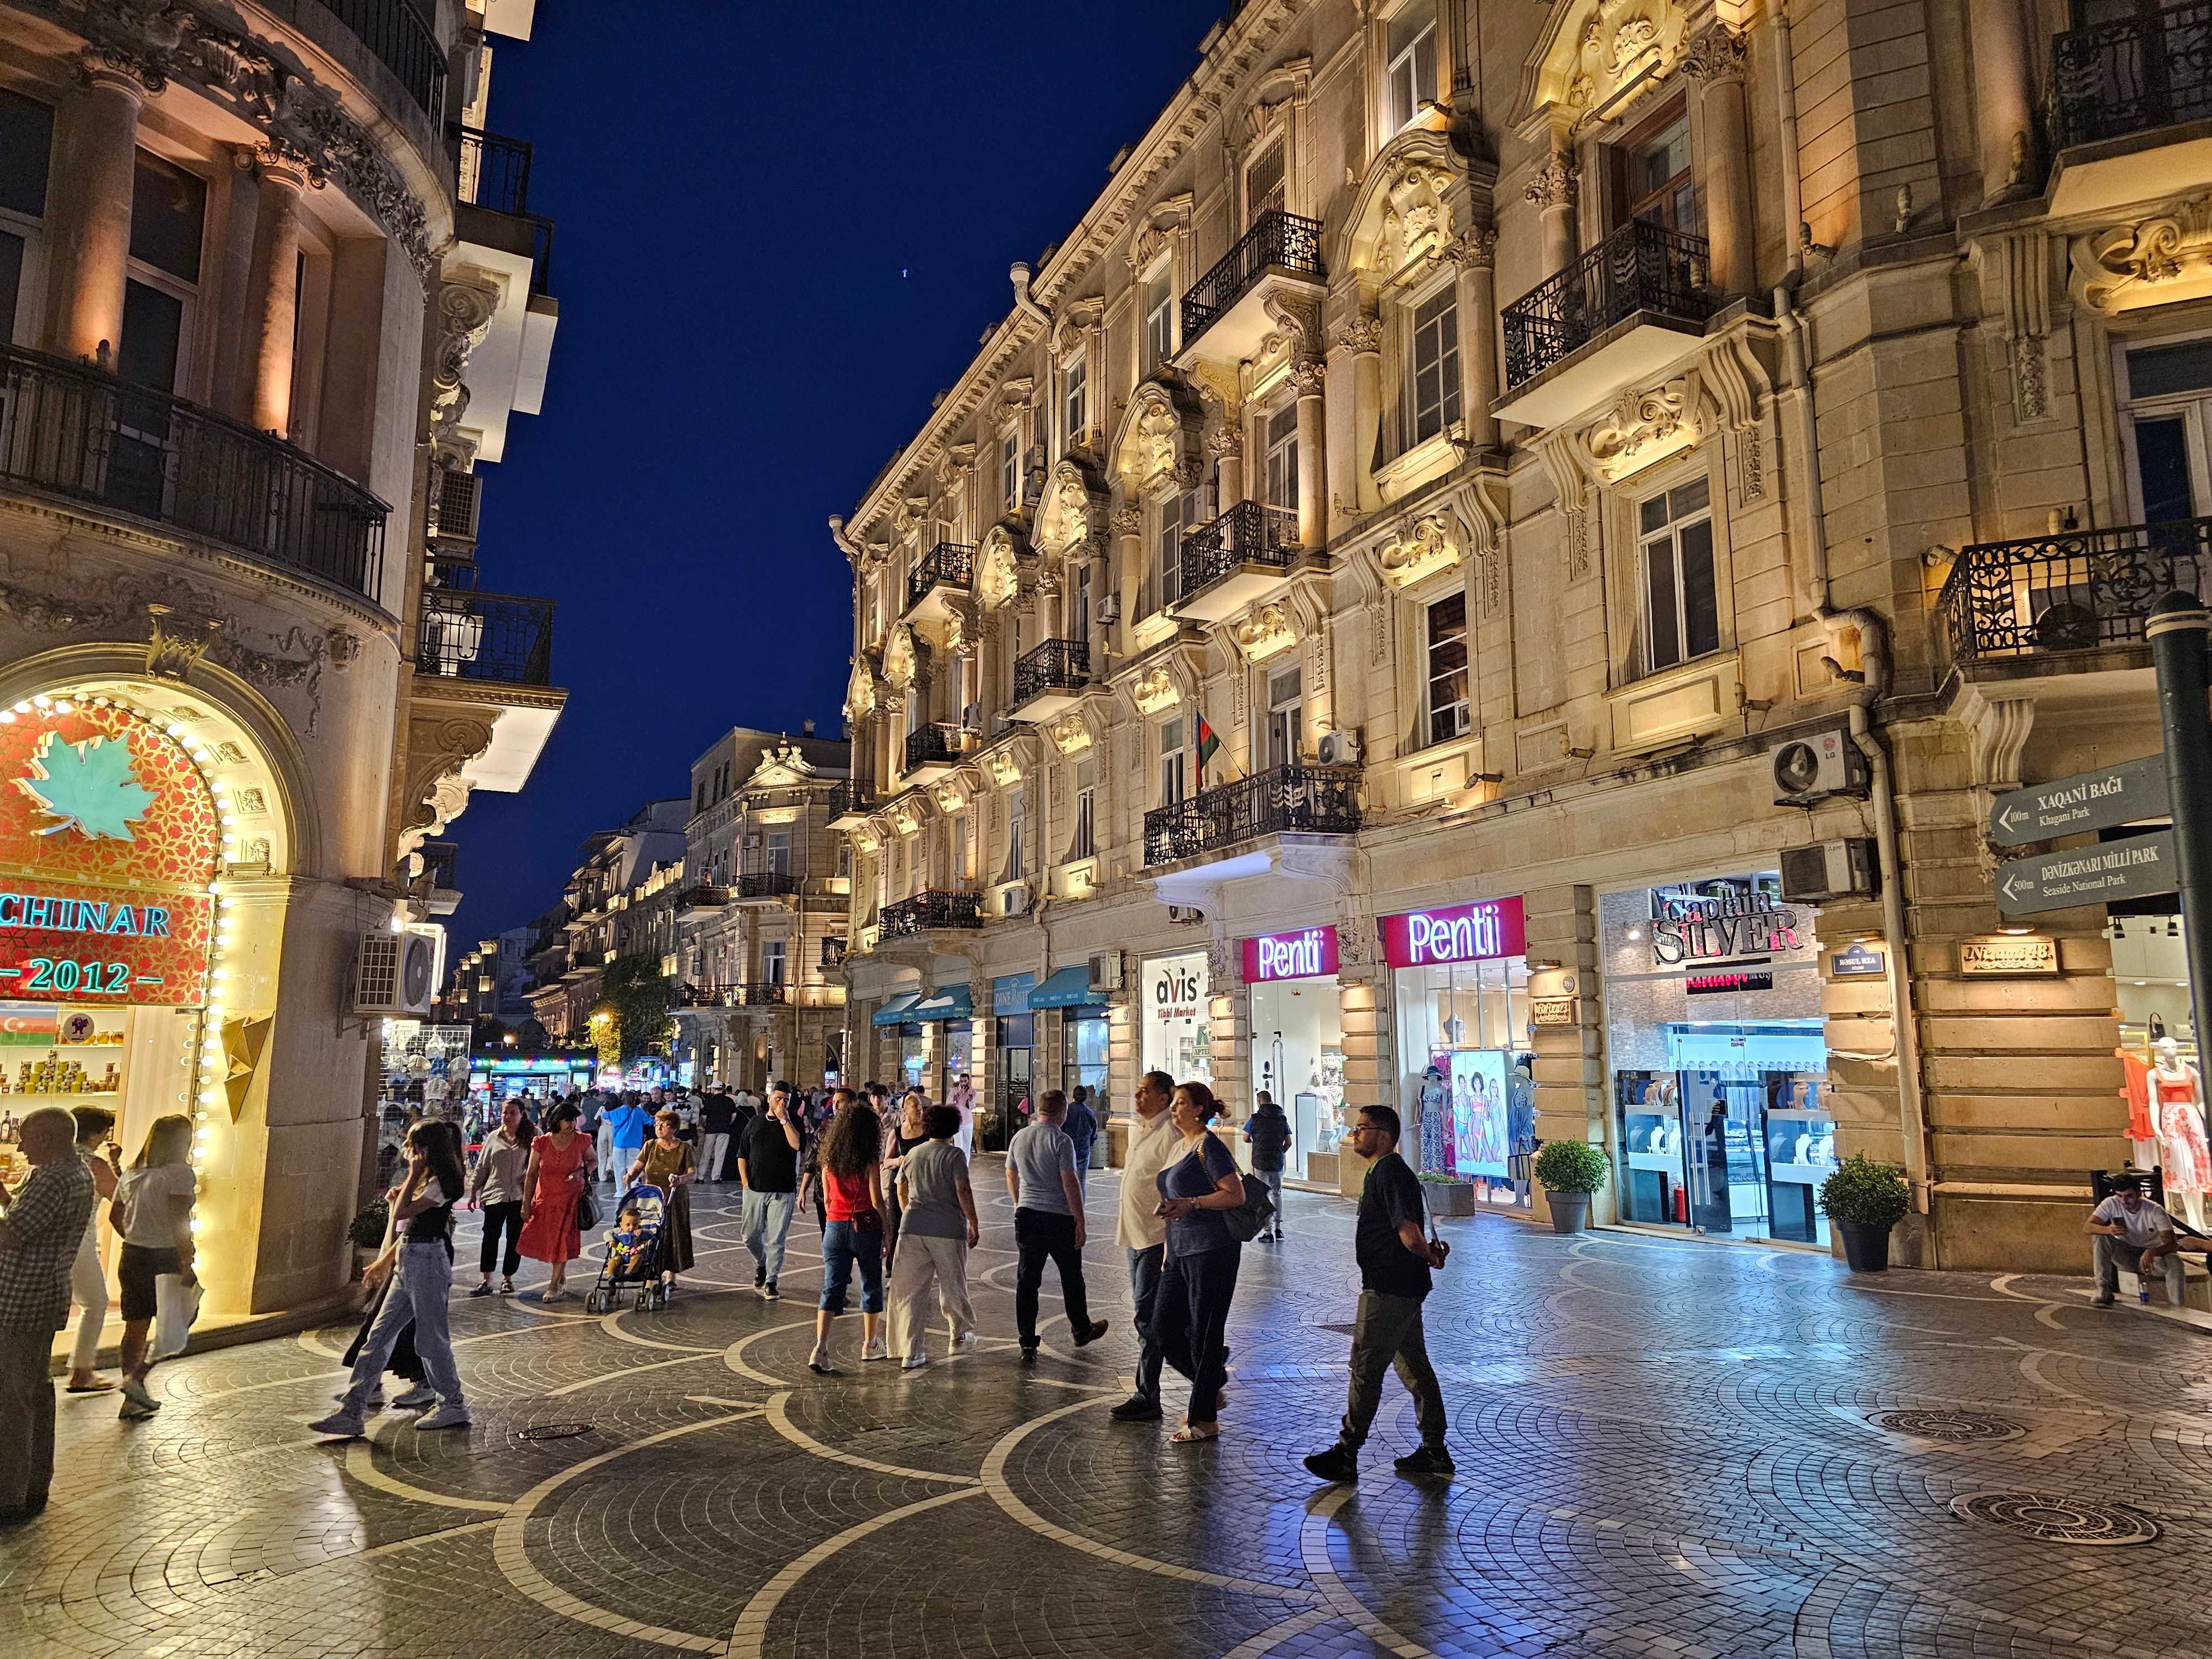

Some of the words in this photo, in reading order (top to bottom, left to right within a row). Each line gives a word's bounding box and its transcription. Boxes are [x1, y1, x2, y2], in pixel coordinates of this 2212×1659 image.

[2037, 783, 2087, 811] XAQANİ
[2089, 776, 2124, 799] BAĞI
[2010, 811, 2029, 823] 100m
[2039, 810, 2070, 826] Khagani
[2072, 806, 2090, 818] Park
[2041, 857, 2101, 881] DƏNİZKƏNARI
[2103, 849, 2131, 870] MİLLİ
[2132, 846, 2159, 865] PARK
[2014, 879, 2034, 891] 500m
[2043, 886, 2070, 897] Seaside
[2072, 877, 2105, 891] National
[2107, 874, 2126, 887] Park
[0, 893, 171, 938] CHINAR
[1663, 888, 1773, 928] Captain
[1408, 905, 1501, 963] Penti
[1652, 910, 1804, 965] SILVER
[1259, 930, 1324, 979] Penti
[28, 958, 130, 993] 2012
[1156, 968, 1197, 1004] avis
[995, 991, 1011, 1006] DINE
[1174, 1006, 1196, 1018] Market
